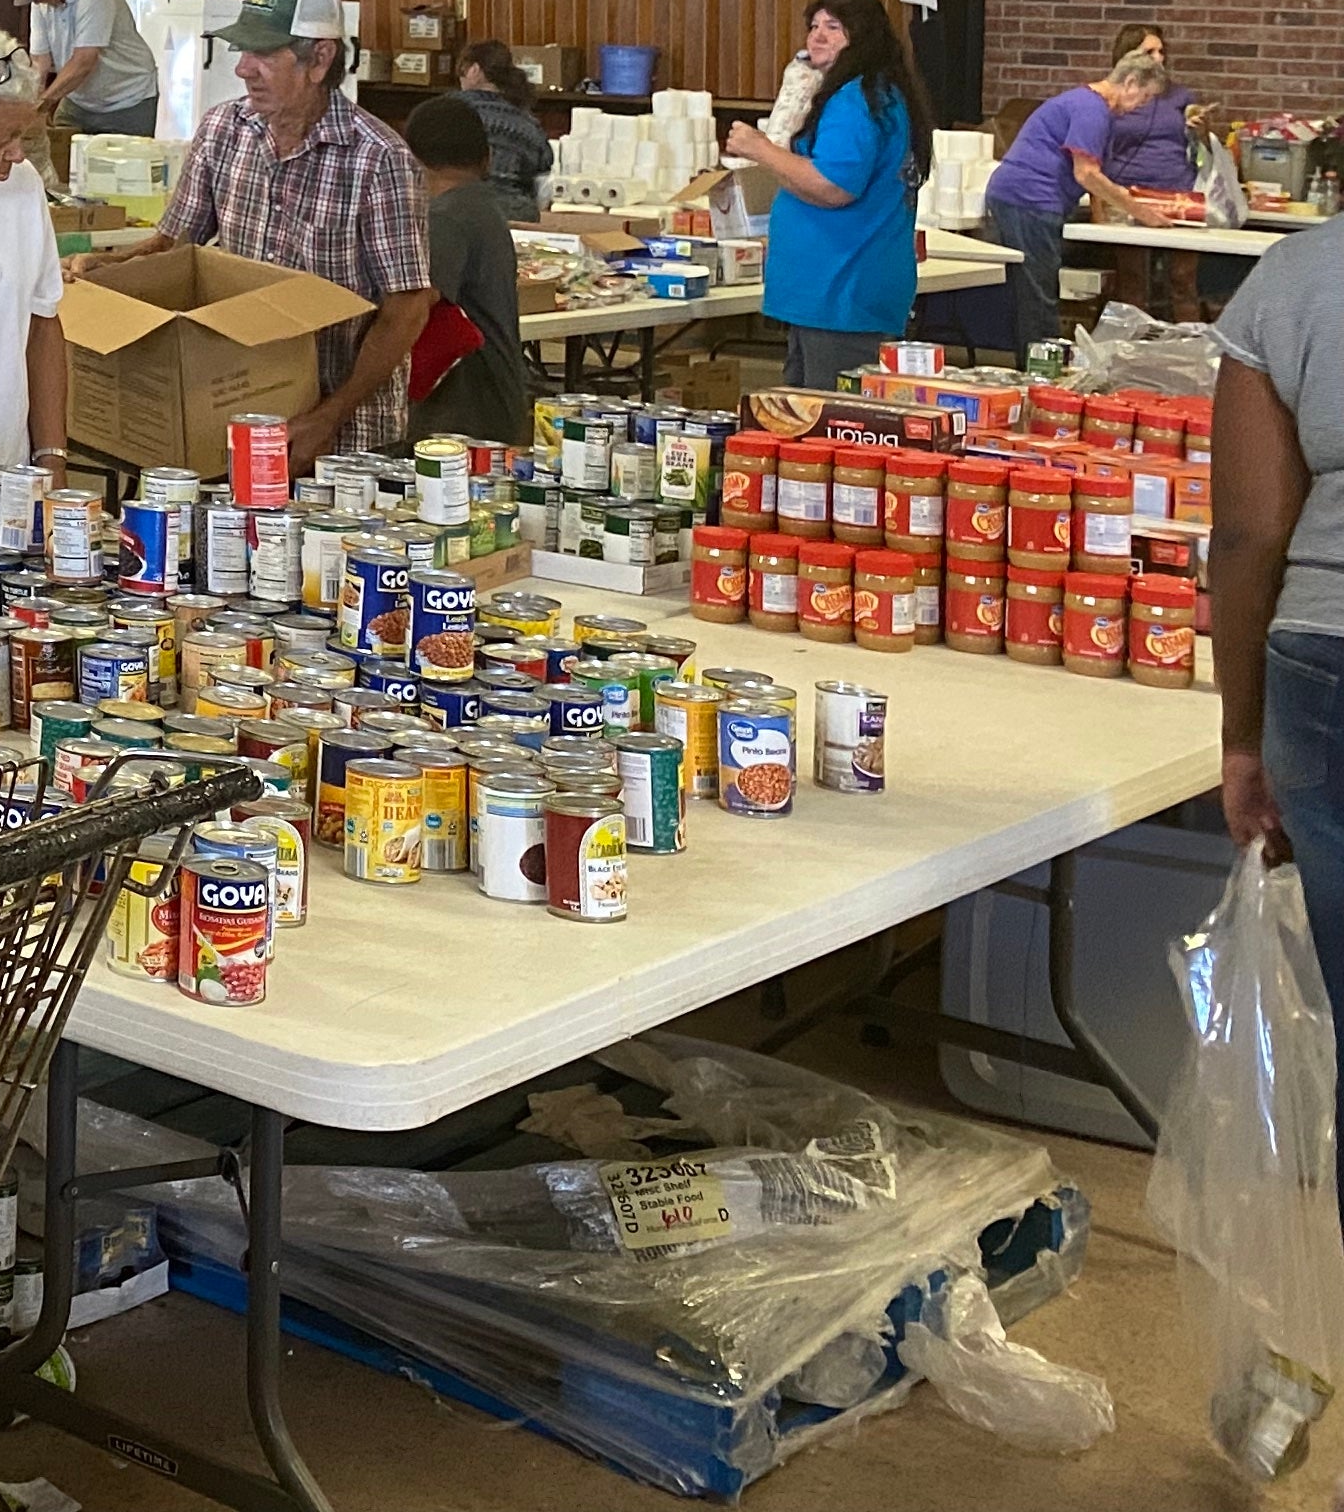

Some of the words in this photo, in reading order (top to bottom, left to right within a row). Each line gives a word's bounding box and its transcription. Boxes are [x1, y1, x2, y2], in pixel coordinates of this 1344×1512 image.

[382, 570, 408, 588] GO
[387, 683, 417, 701] GO
[566, 707, 603, 727] GOY
[742, 746, 763, 755] Pinto
[383, 805, 422, 821] BEAN
[202, 884, 266, 906] GOYA
[664, 1178, 692, 1190] Shelf
[639, 1195, 675, 1210] Stable
[677, 1191, 705, 1205] Food
[718, 1207, 730, 1223] D
[115, 1440, 172, 1470] LIFETIME
